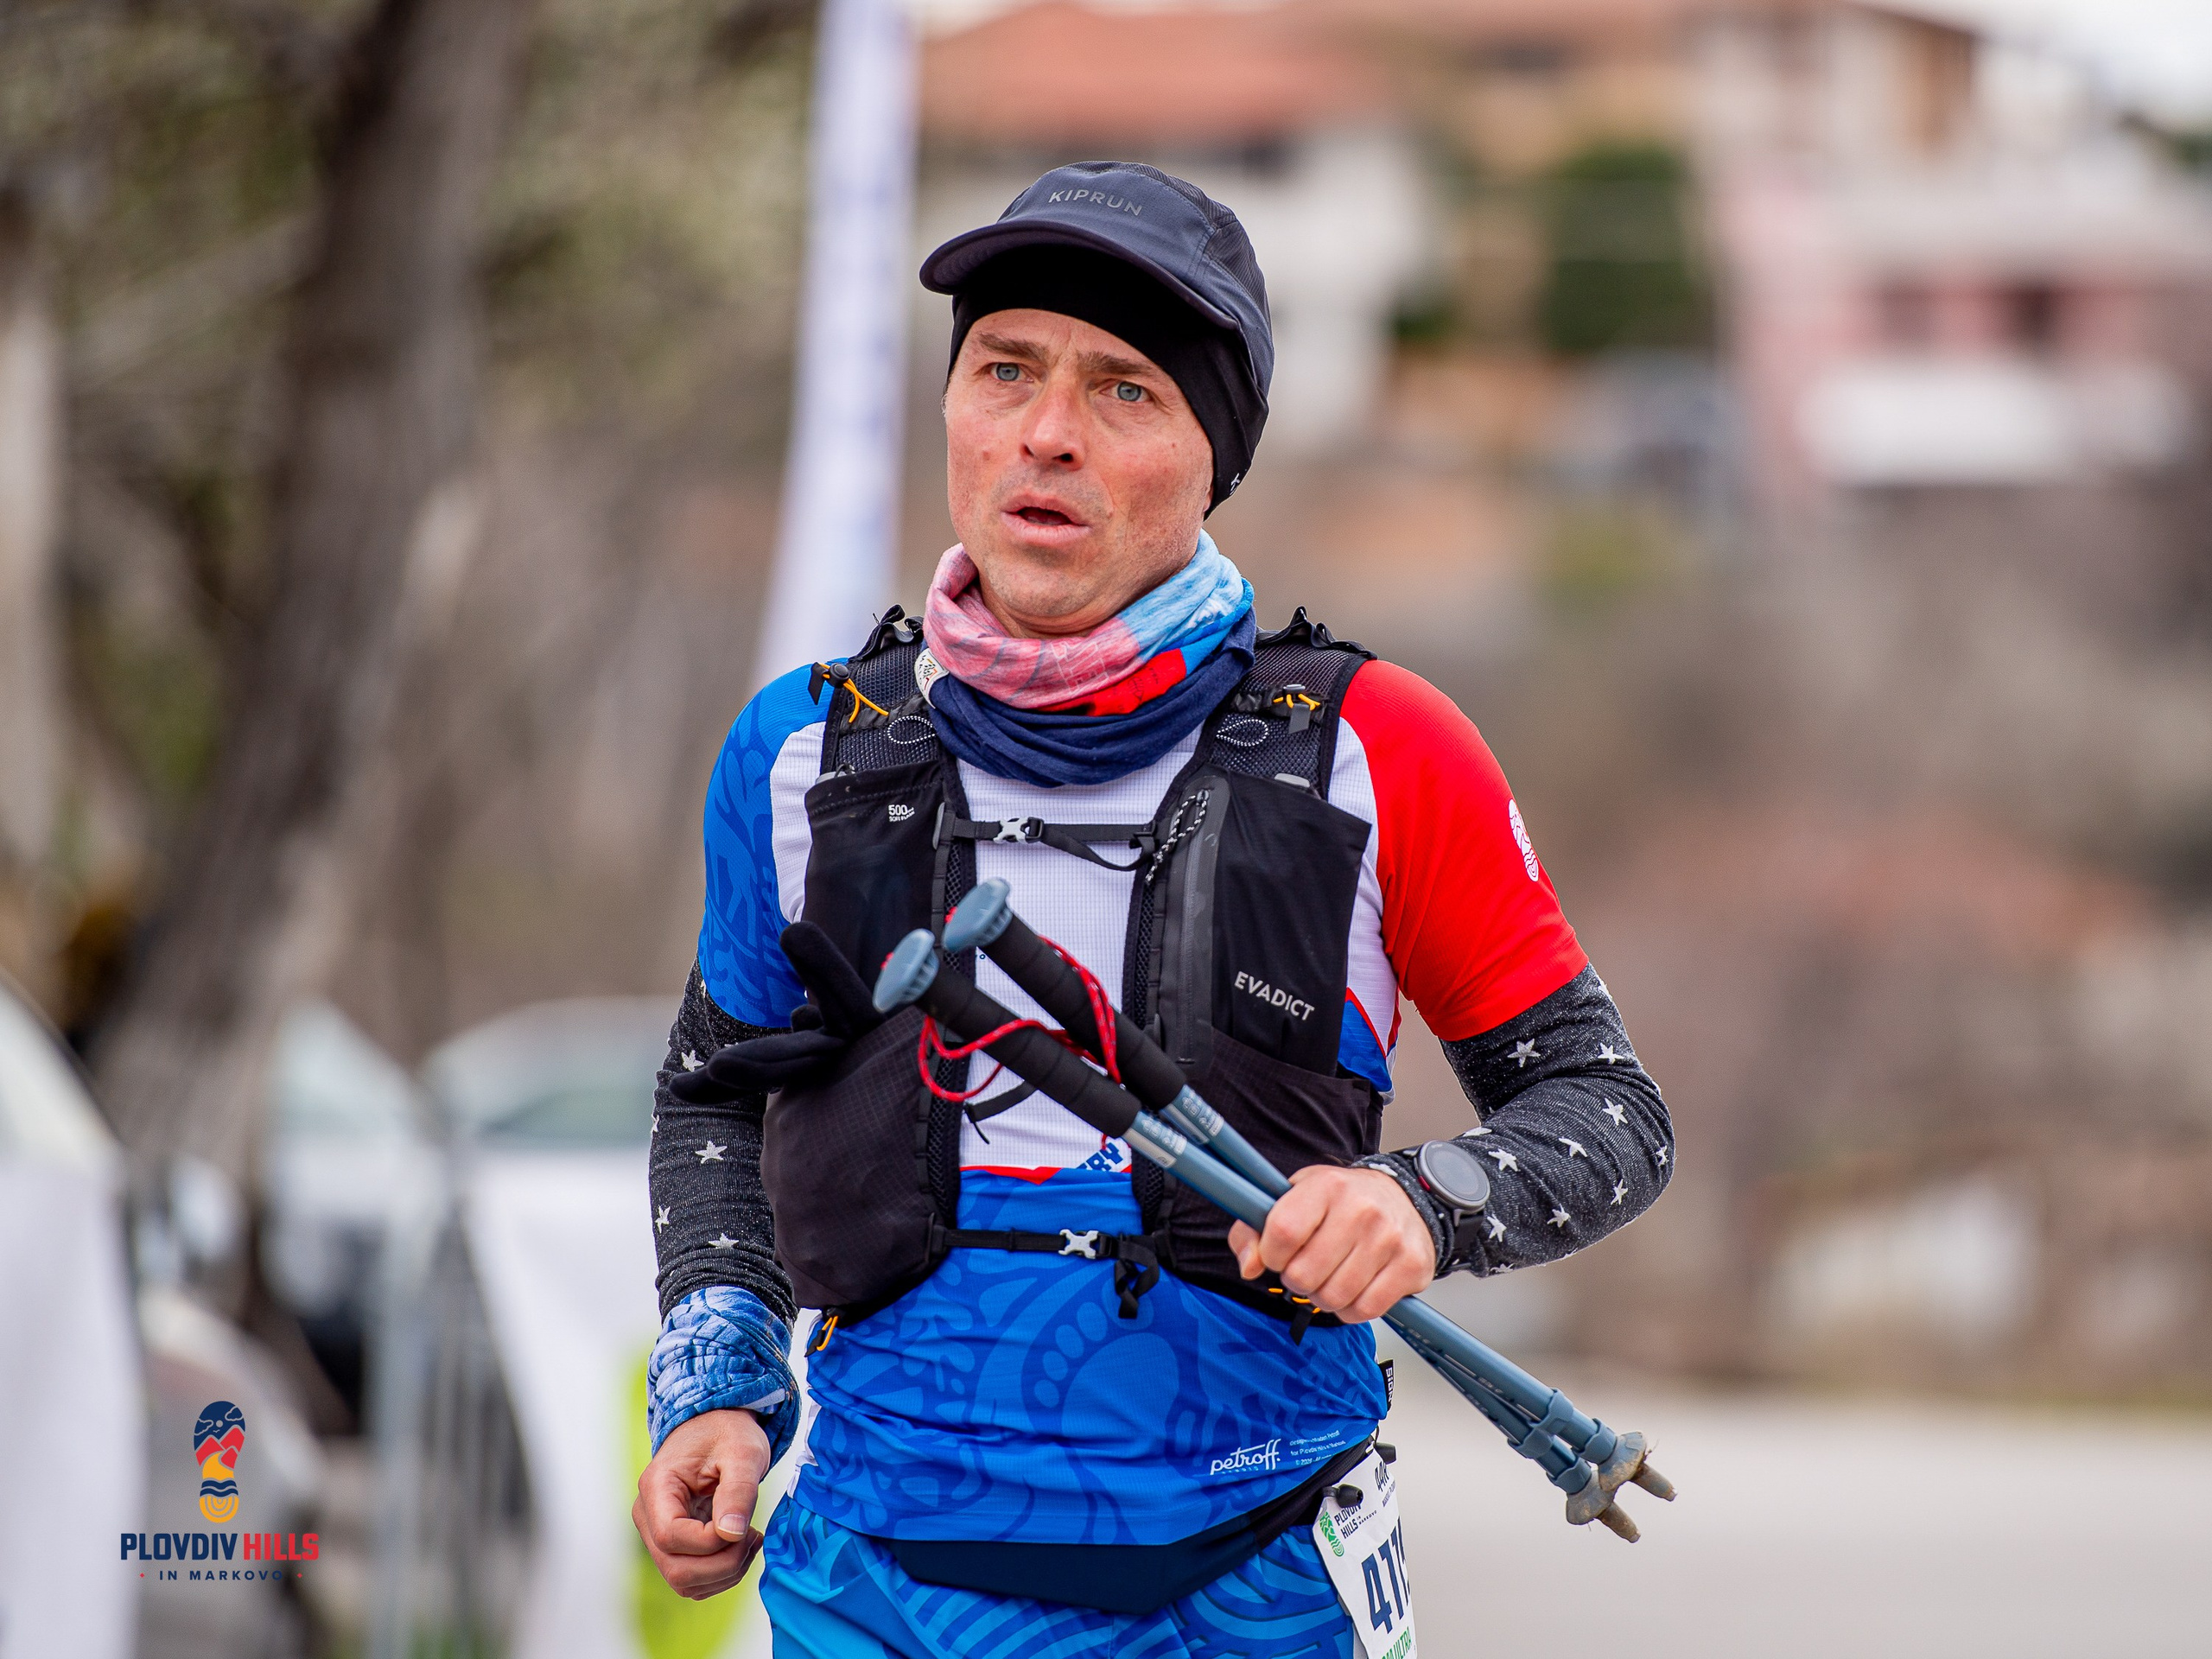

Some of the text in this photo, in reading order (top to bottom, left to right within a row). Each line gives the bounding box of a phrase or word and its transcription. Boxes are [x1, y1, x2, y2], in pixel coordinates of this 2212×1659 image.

[1048, 189, 1142, 216] KIPRUN
[1234, 970, 1315, 1020] EVADICT
[1340, 1519, 1358, 1539] HILLS
